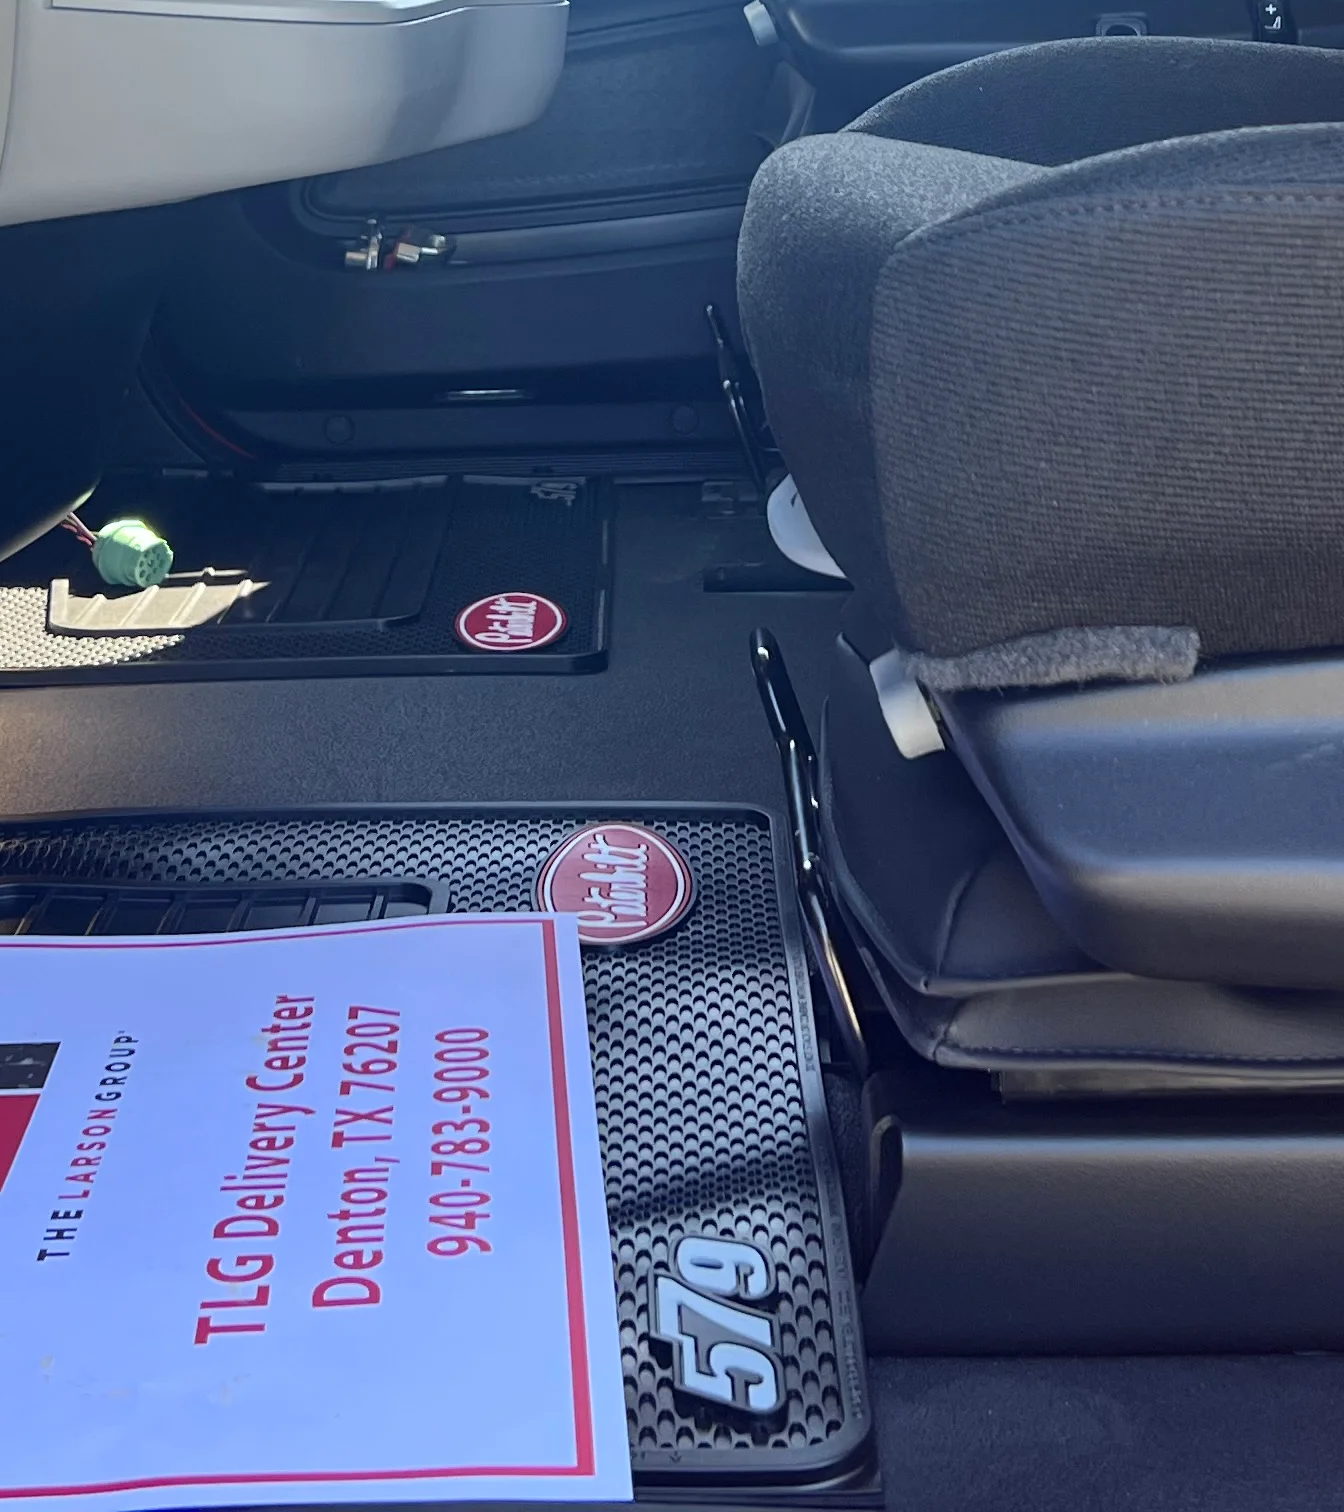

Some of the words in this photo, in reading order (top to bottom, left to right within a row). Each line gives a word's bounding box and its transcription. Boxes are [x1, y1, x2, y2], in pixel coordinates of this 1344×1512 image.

[578, 833, 649, 928] Peterbilt
[94, 1034, 140, 1102] GROUP
[245, 994, 316, 1092] Center
[339, 1005, 401, 1096] 76207
[58, 1107, 118, 1200] LARSON
[213, 1102, 317, 1239] Delivery
[331, 1104, 395, 1149] TX
[426, 1027, 493, 1257] 940-783-9000
[36, 1208, 84, 1262] THE
[311, 1155, 401, 1308] Denton,
[194, 1253, 276, 1345] TLG
[651, 1237, 781, 1412] 579
